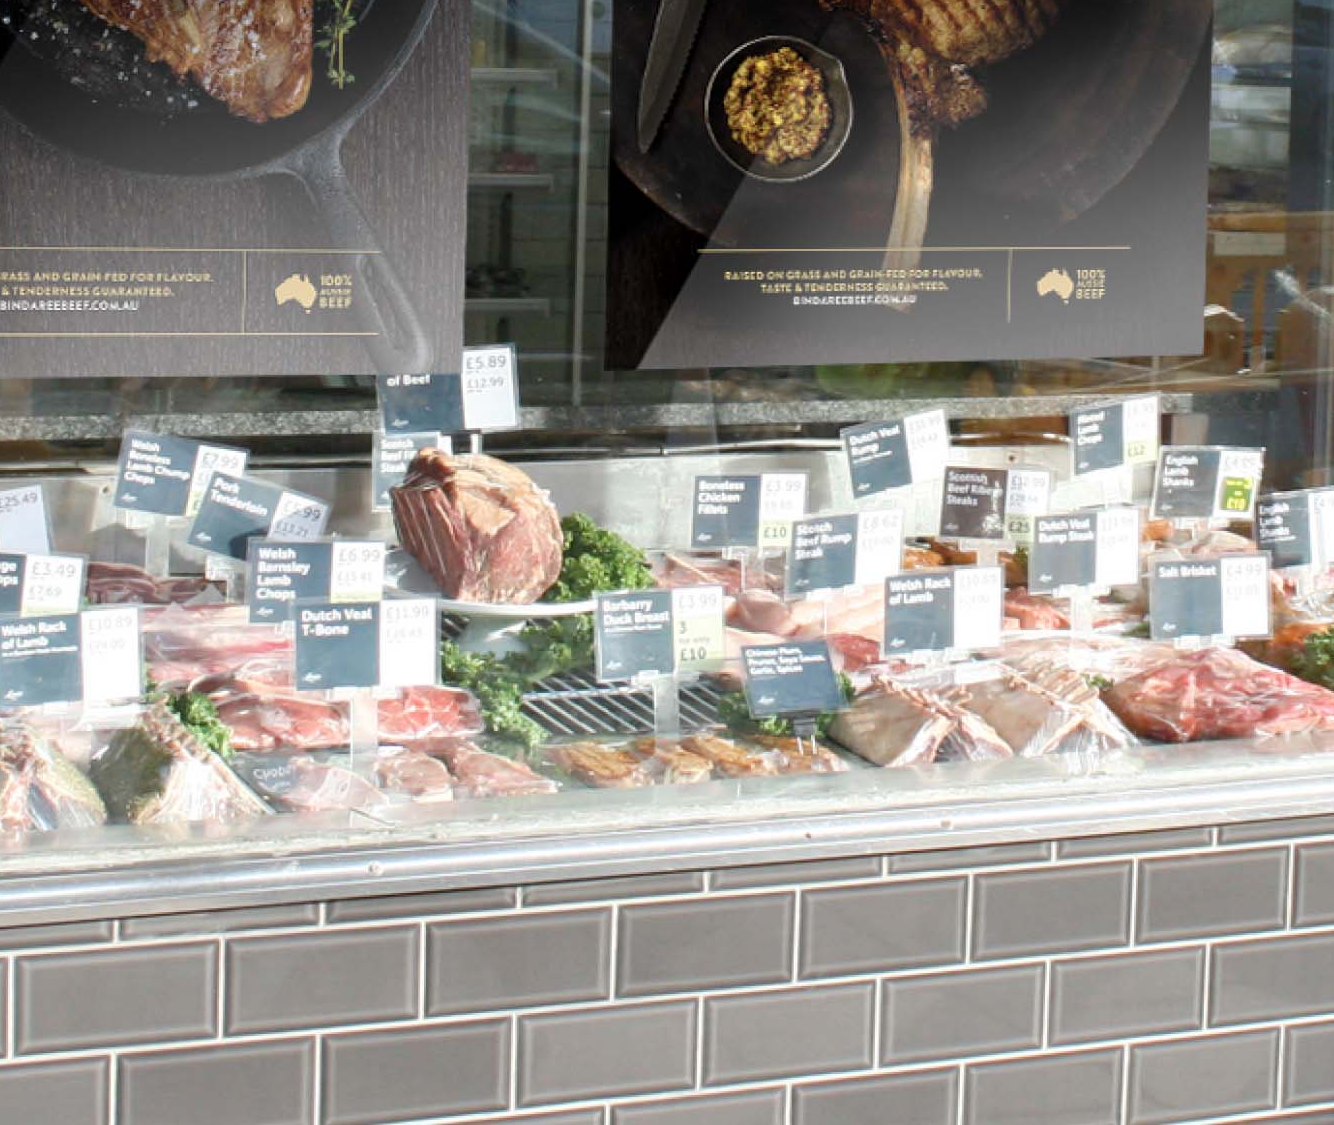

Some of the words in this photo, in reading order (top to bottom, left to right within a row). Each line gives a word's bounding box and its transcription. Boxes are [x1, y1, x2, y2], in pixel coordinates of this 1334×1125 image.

[33, 271, 60, 282] AND
[63, 272, 101, 282] GRAIN
[130, 273, 155, 282] FOR
[320, 274, 352, 286] 100%
[723, 271, 764, 281] RAISED
[767, 270, 784, 280] ON
[786, 270, 821, 280] GRASS
[823, 269, 847, 279] AND
[1076, 269, 1106, 279] 100%
[12, 286, 90, 296] TENDERNESS
[760, 283, 792, 293] TASTE
[805, 283, 874, 293] TENDERNESS
[1076, 289, 1106, 299] BEEF
[319, 297, 352, 309] BEEF
[466, 355, 507, 370] £5.89
[386, 377, 400, 387] of
[402, 374, 431, 386] Beef
[698, 493, 741, 503] Chicken
[764, 526, 787, 538] £10
[259, 548, 297, 560] Welsh
[32, 561, 77, 577] £3.49
[257, 575, 292, 586] Lamb
[889, 578, 923, 591] Welsh
[924, 577, 951, 589] Rack
[256, 588, 296, 602] Chops
[889, 593, 902, 605] of
[903, 592, 935, 604] Lamb
[301, 608, 342, 622] Dutch
[345, 607, 373, 620] Veal
[38, 621, 67, 632] Rack
[302, 624, 350, 636] T-Bone
[679, 620, 688, 634] 3
[17, 636, 49, 648] Lamb
[681, 646, 708, 661] £10
